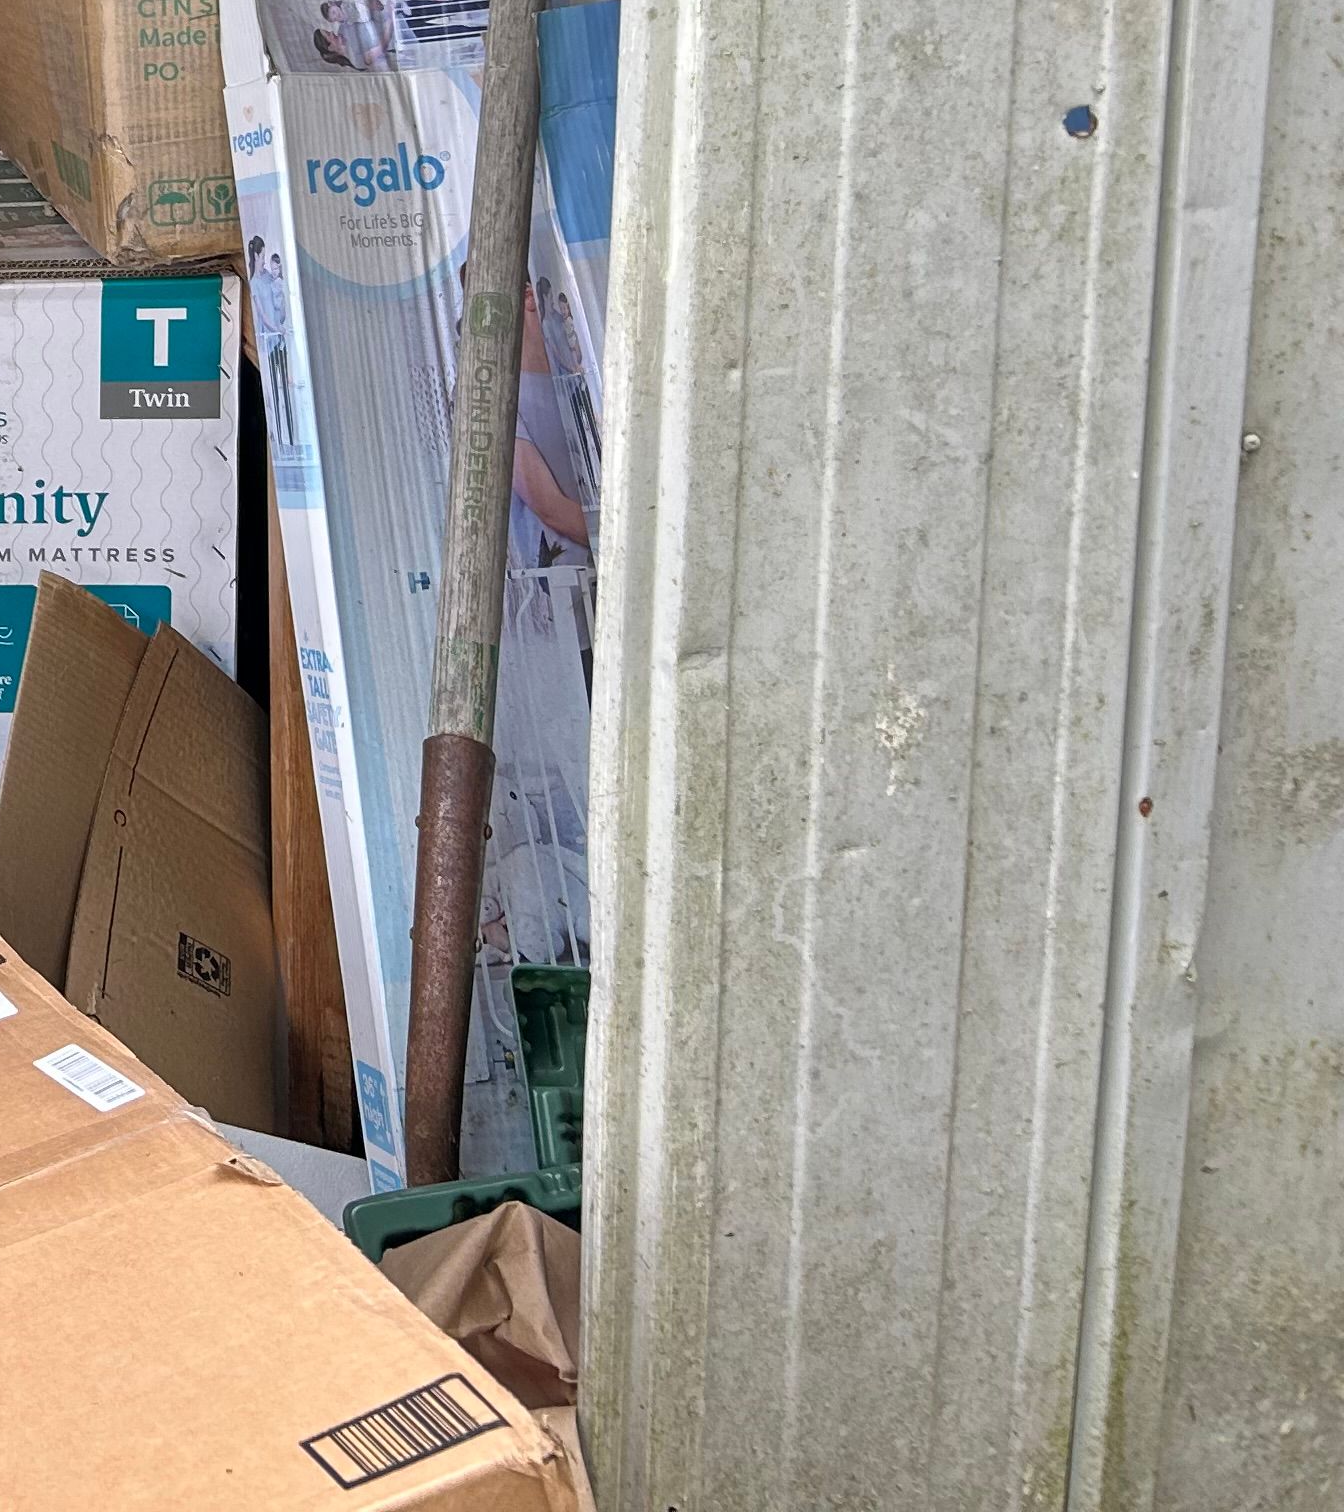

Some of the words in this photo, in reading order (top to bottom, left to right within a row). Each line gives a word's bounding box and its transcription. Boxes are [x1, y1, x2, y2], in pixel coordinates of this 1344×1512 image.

[139, 25, 207, 49] Made
[143, 61, 185, 81] PO:
[232, 122, 273, 156] regalo
[306, 141, 445, 208] regalo
[339, 214, 362, 231] For
[363, 213, 398, 230] Life's
[399, 212, 424, 228] BIG
[136, 307, 187, 367] T
[129, 388, 190, 409] Twin
[471, 360, 497, 422] JOHN
[464, 433, 492, 521] DEERE
[28, 547, 176, 563] MATTRESS
[300, 647, 333, 673] EXTRA
[308, 676, 330, 700] TALL
